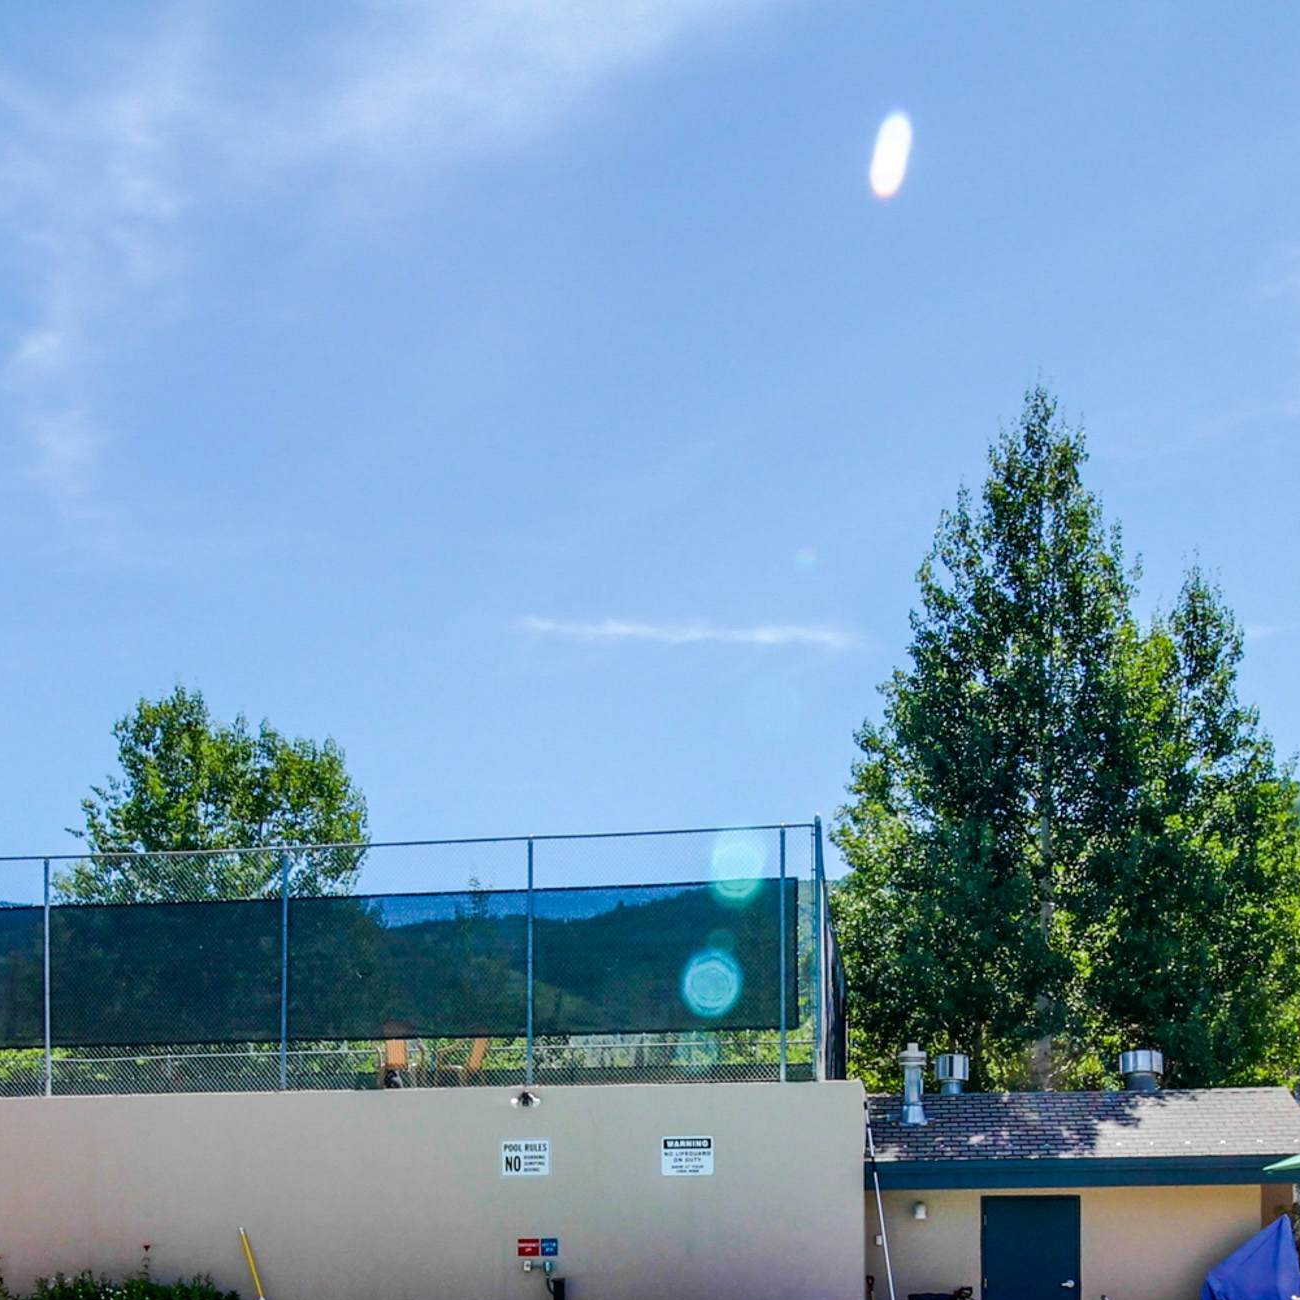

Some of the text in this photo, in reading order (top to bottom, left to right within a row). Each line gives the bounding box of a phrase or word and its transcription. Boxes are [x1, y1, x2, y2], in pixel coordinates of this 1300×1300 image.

[503, 1143, 547, 1152] POOL RULES
[666, 1140, 709, 1148] WARNING
[505, 1155, 521, 1172] NO
